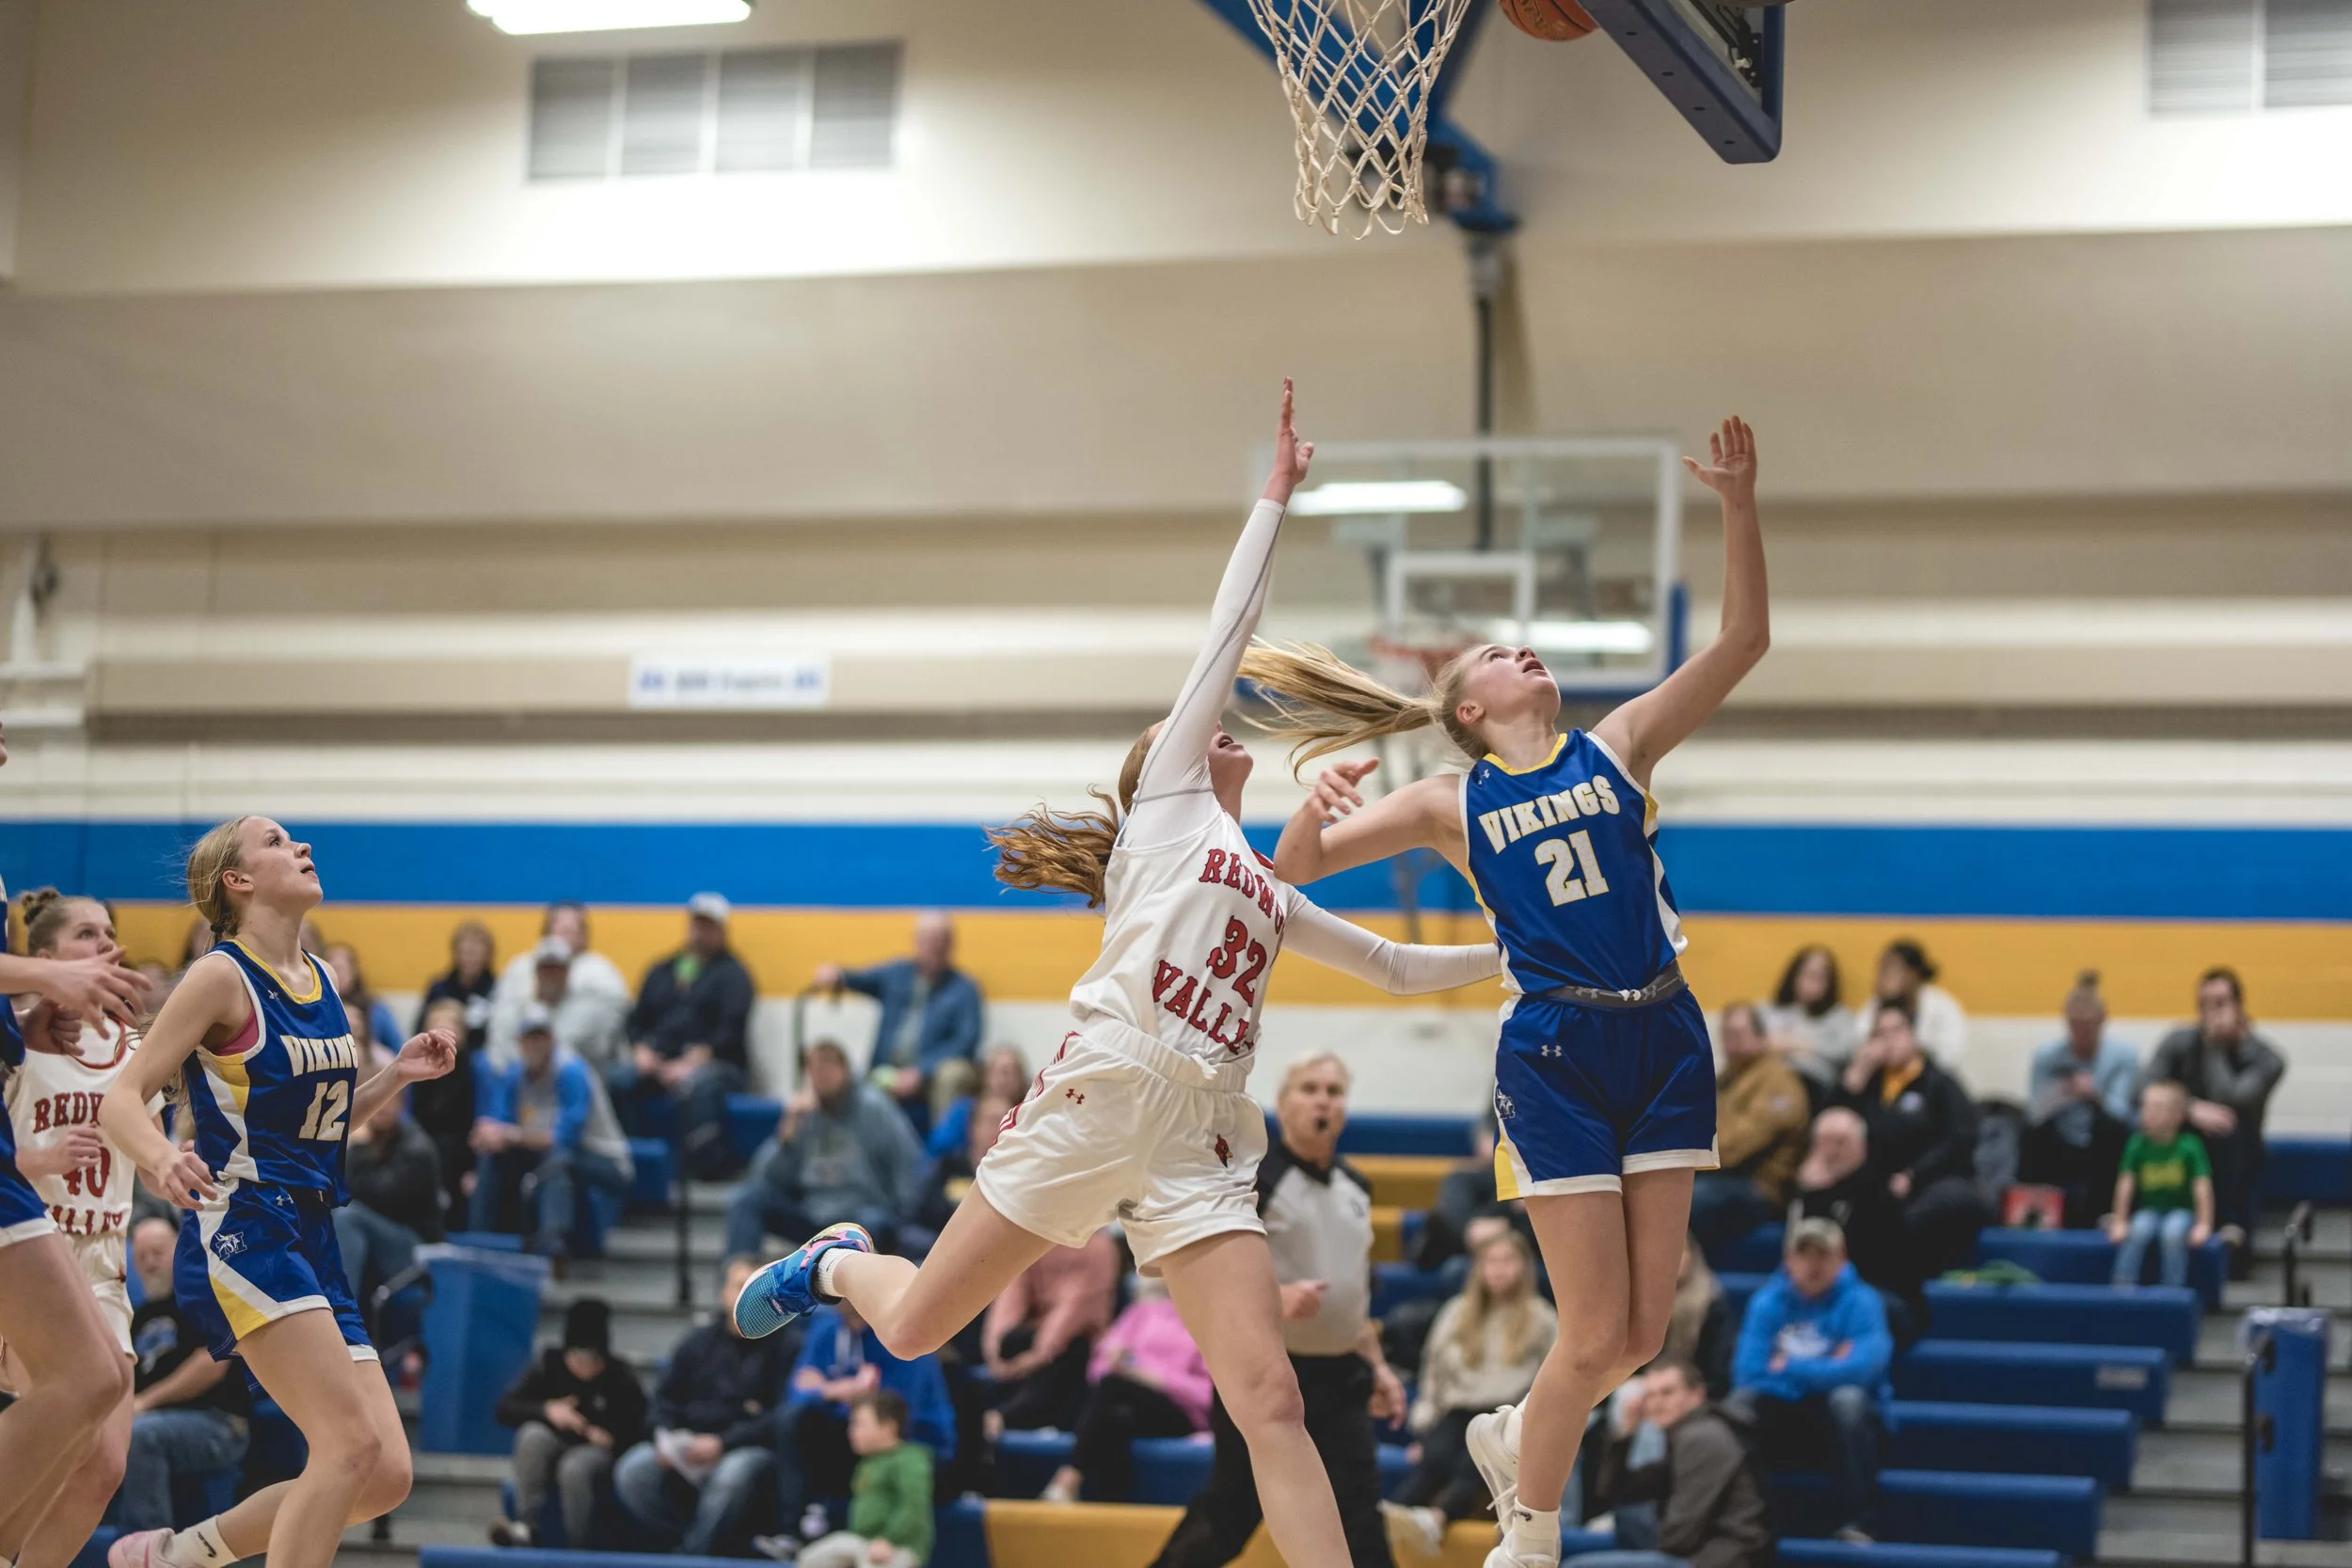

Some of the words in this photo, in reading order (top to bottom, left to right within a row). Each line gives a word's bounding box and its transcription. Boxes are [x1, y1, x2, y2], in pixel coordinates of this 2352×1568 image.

[1478, 774, 1621, 854] VIKINGS
[1534, 829, 1610, 907] 21
[1206, 915, 1267, 1006] 32
[298, 1079, 349, 1141] 12
